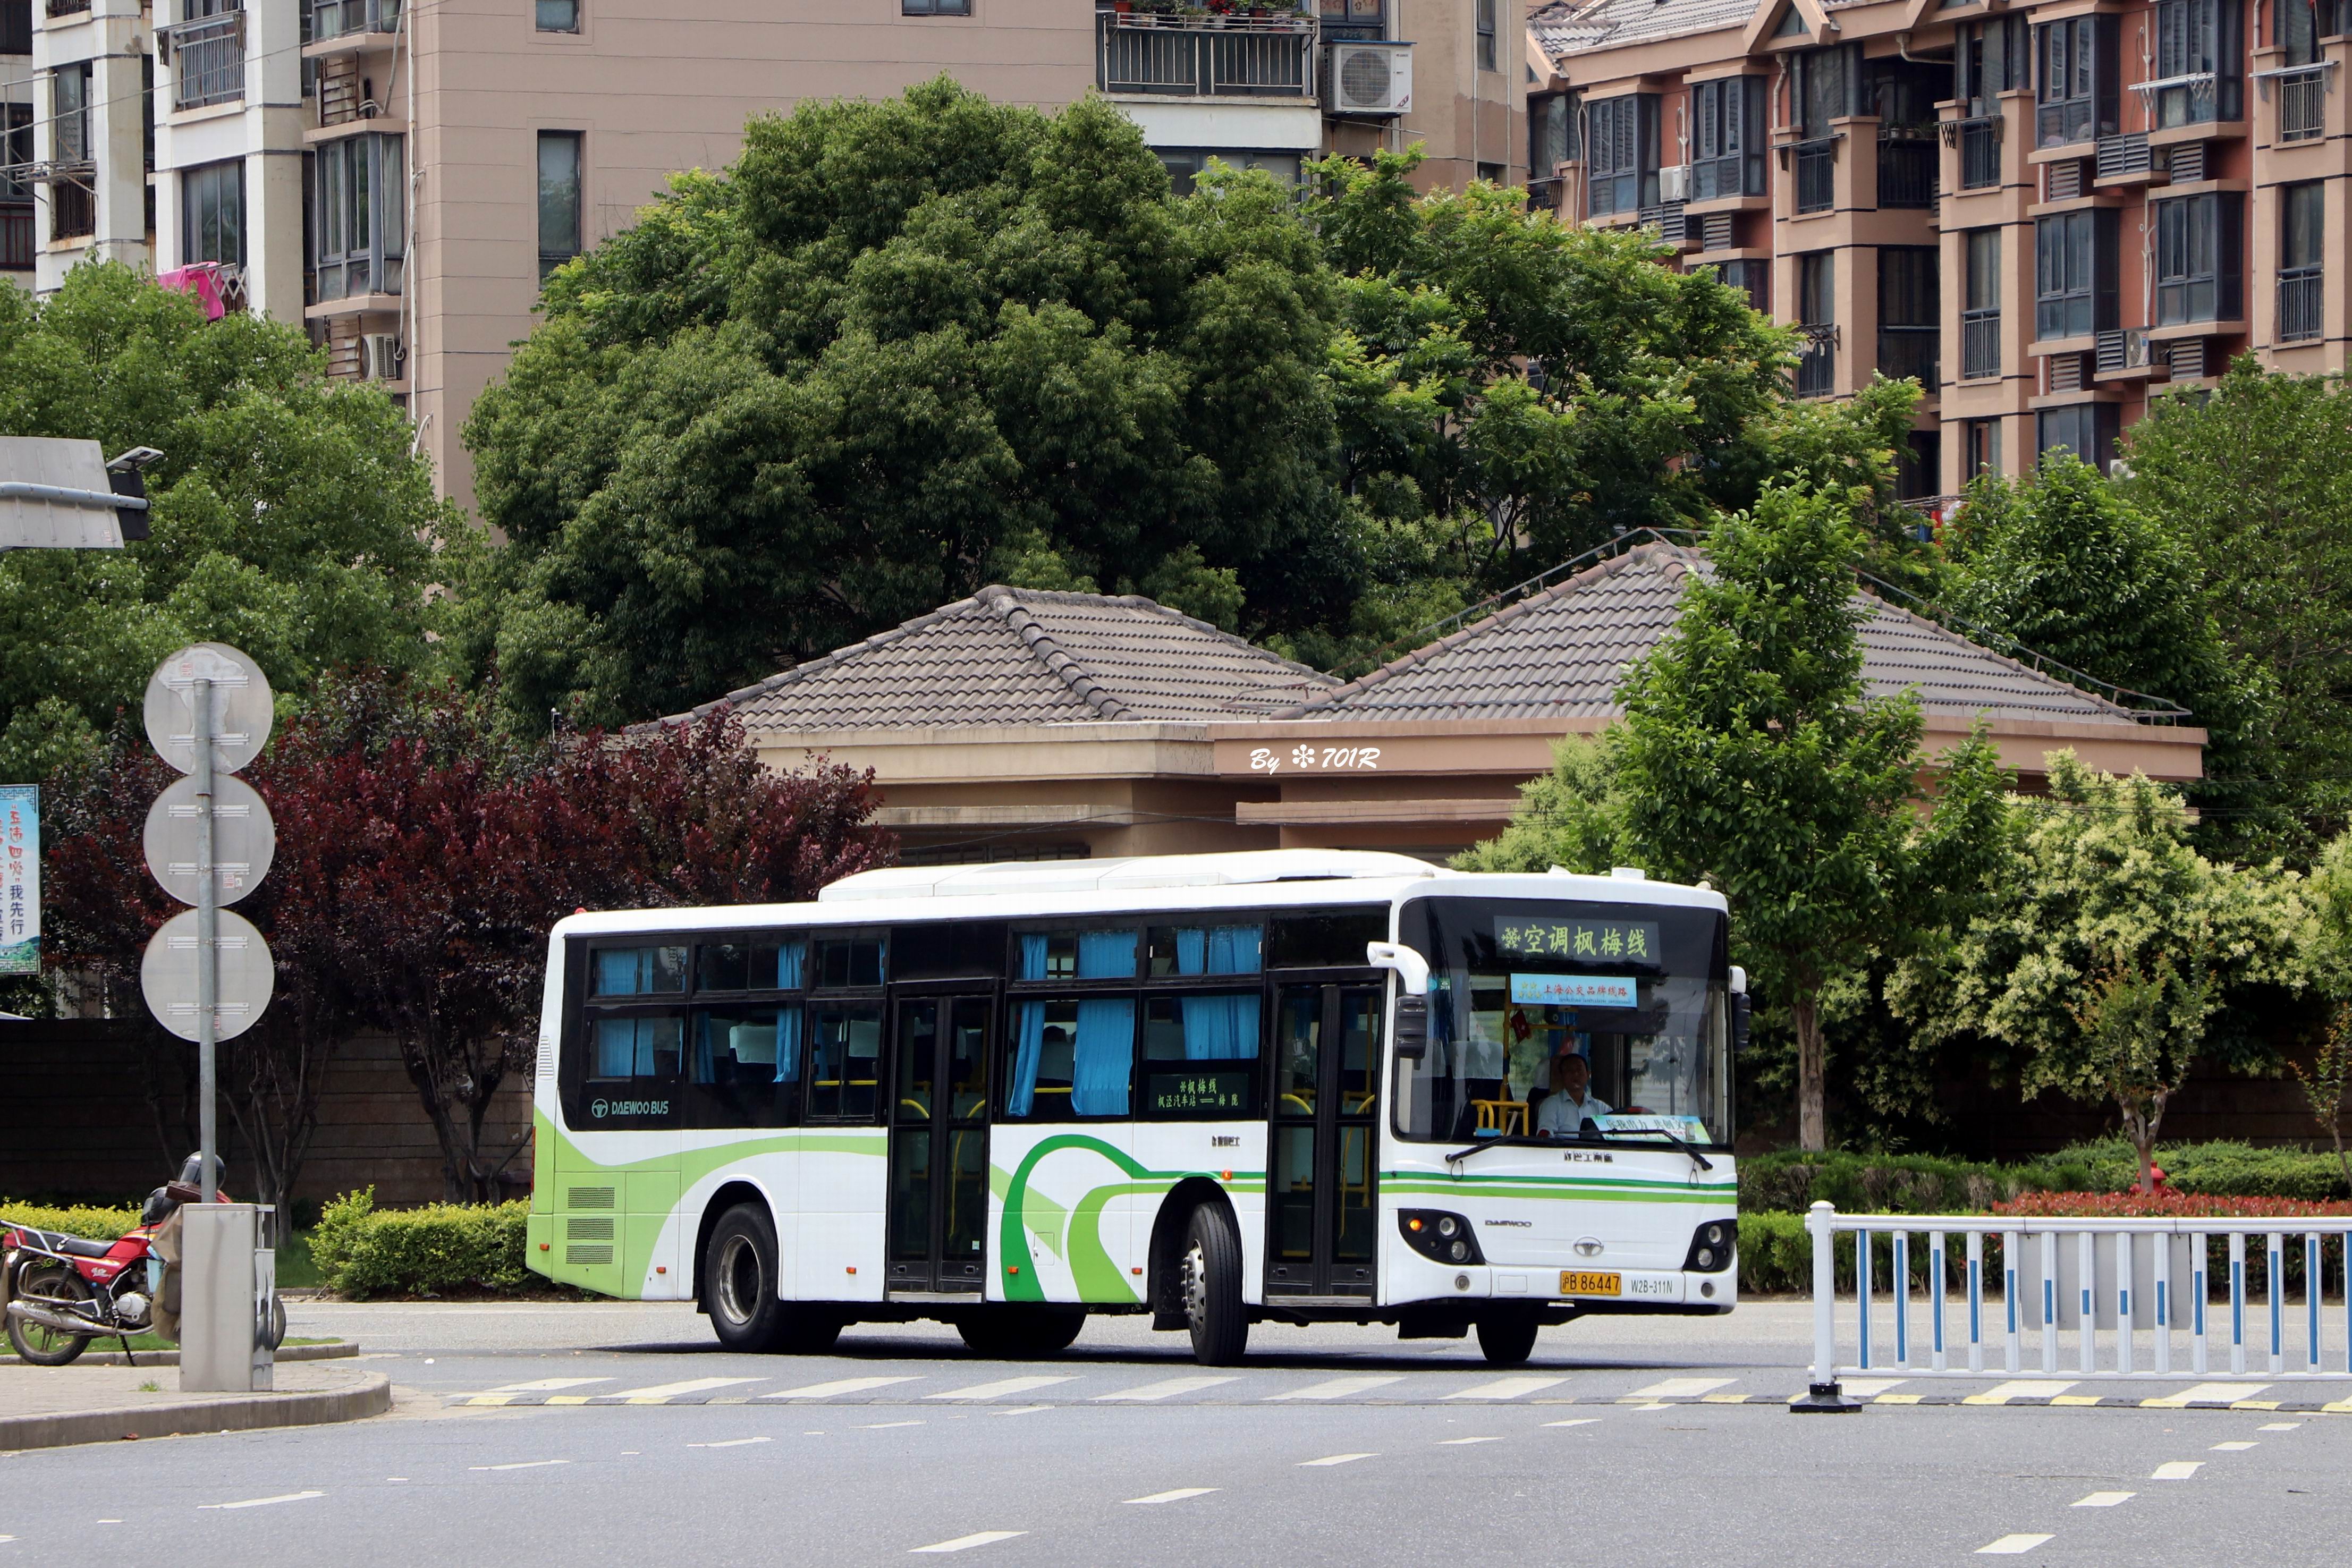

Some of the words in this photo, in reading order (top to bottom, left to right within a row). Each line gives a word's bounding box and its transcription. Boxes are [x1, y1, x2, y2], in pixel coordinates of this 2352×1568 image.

[1524, 923, 1647, 957] 空调枫梅线
[1543, 984, 1628, 997] 上海公交品牌线路
[1188, 1078, 1217, 1095] 枫梅线
[612, 1101, 649, 1115] DAEWOO
[650, 1100, 669, 1115] BUS
[1157, 1094, 1196, 1108] 枫泾汽车站
[1631, 1279, 1673, 1294] W2B-311N
